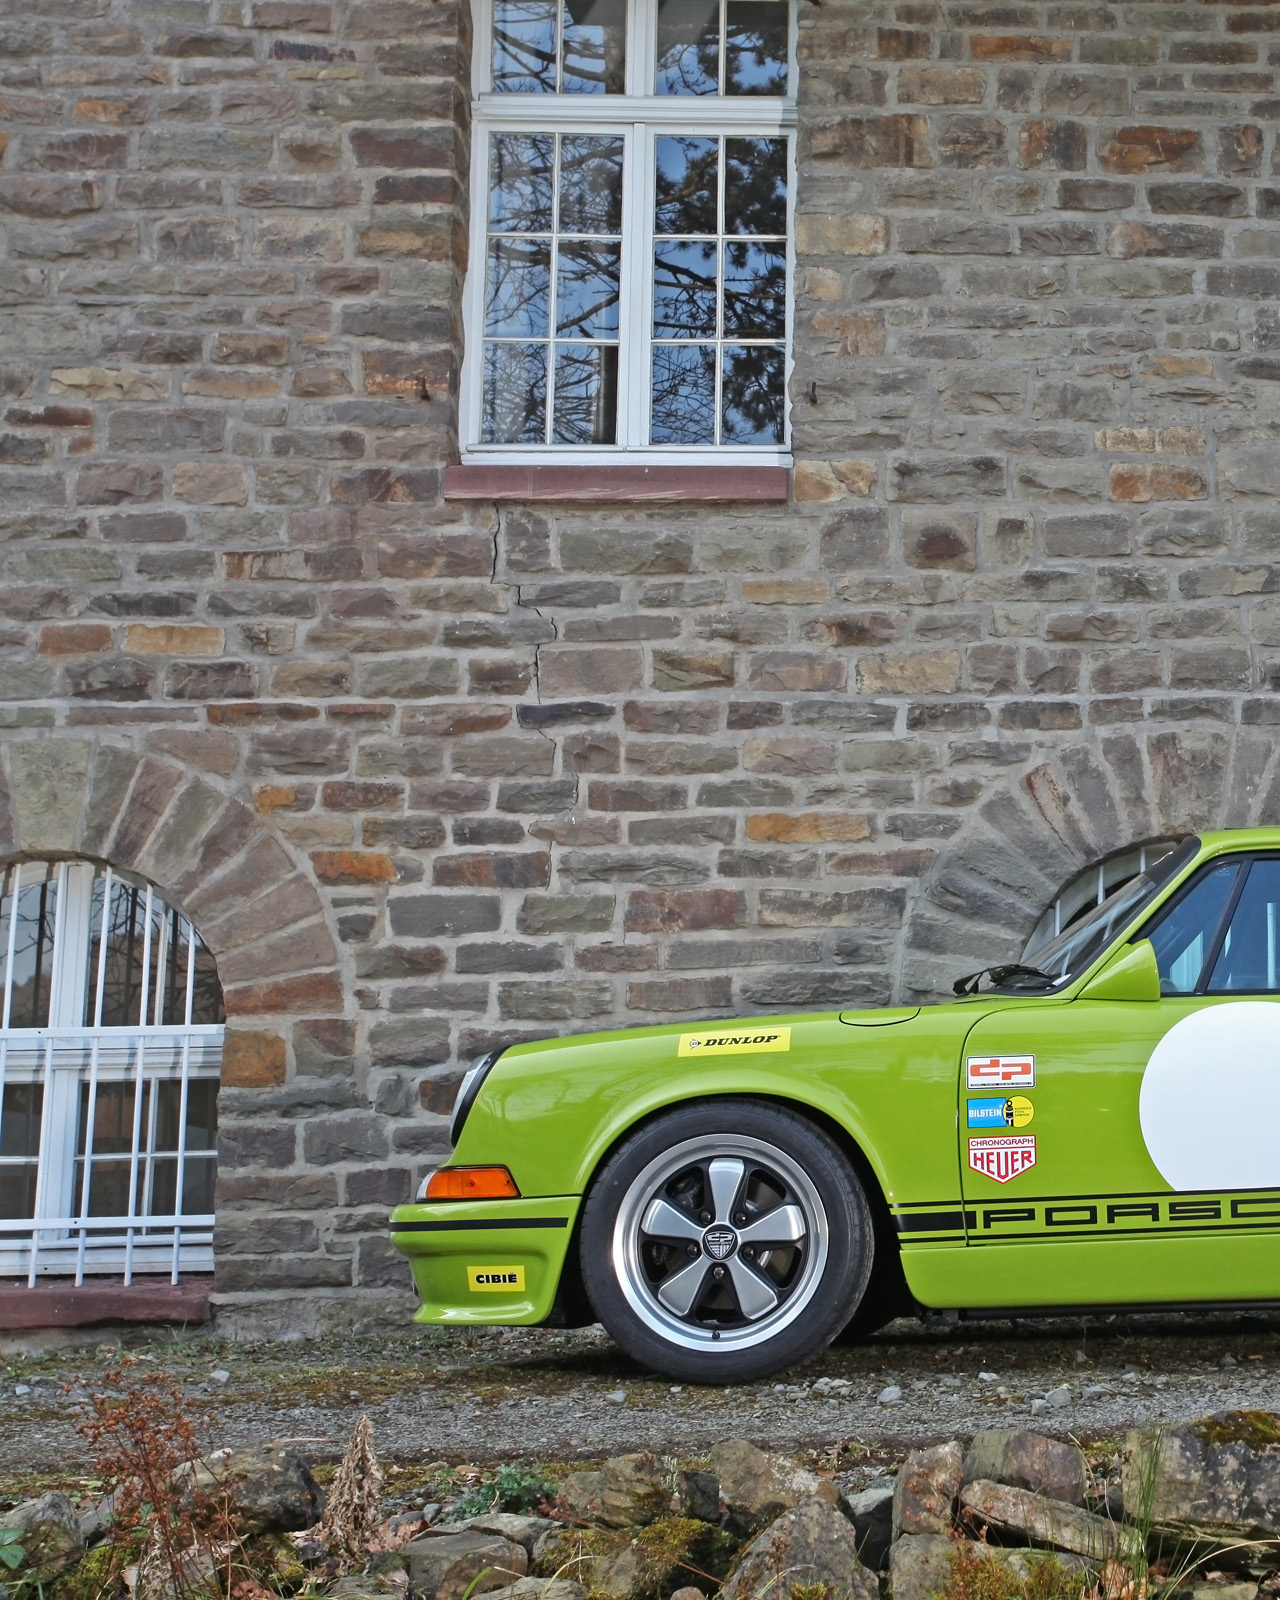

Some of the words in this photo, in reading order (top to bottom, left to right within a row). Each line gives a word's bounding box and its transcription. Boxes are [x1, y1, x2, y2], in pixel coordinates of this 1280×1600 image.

[703, 1035, 779, 1047] DUNLOP
[968, 1108, 1002, 1118] BILSTEIN
[970, 1138, 1034, 1147] CHRONOGRAPH
[973, 1150, 1033, 1180] HEUER
